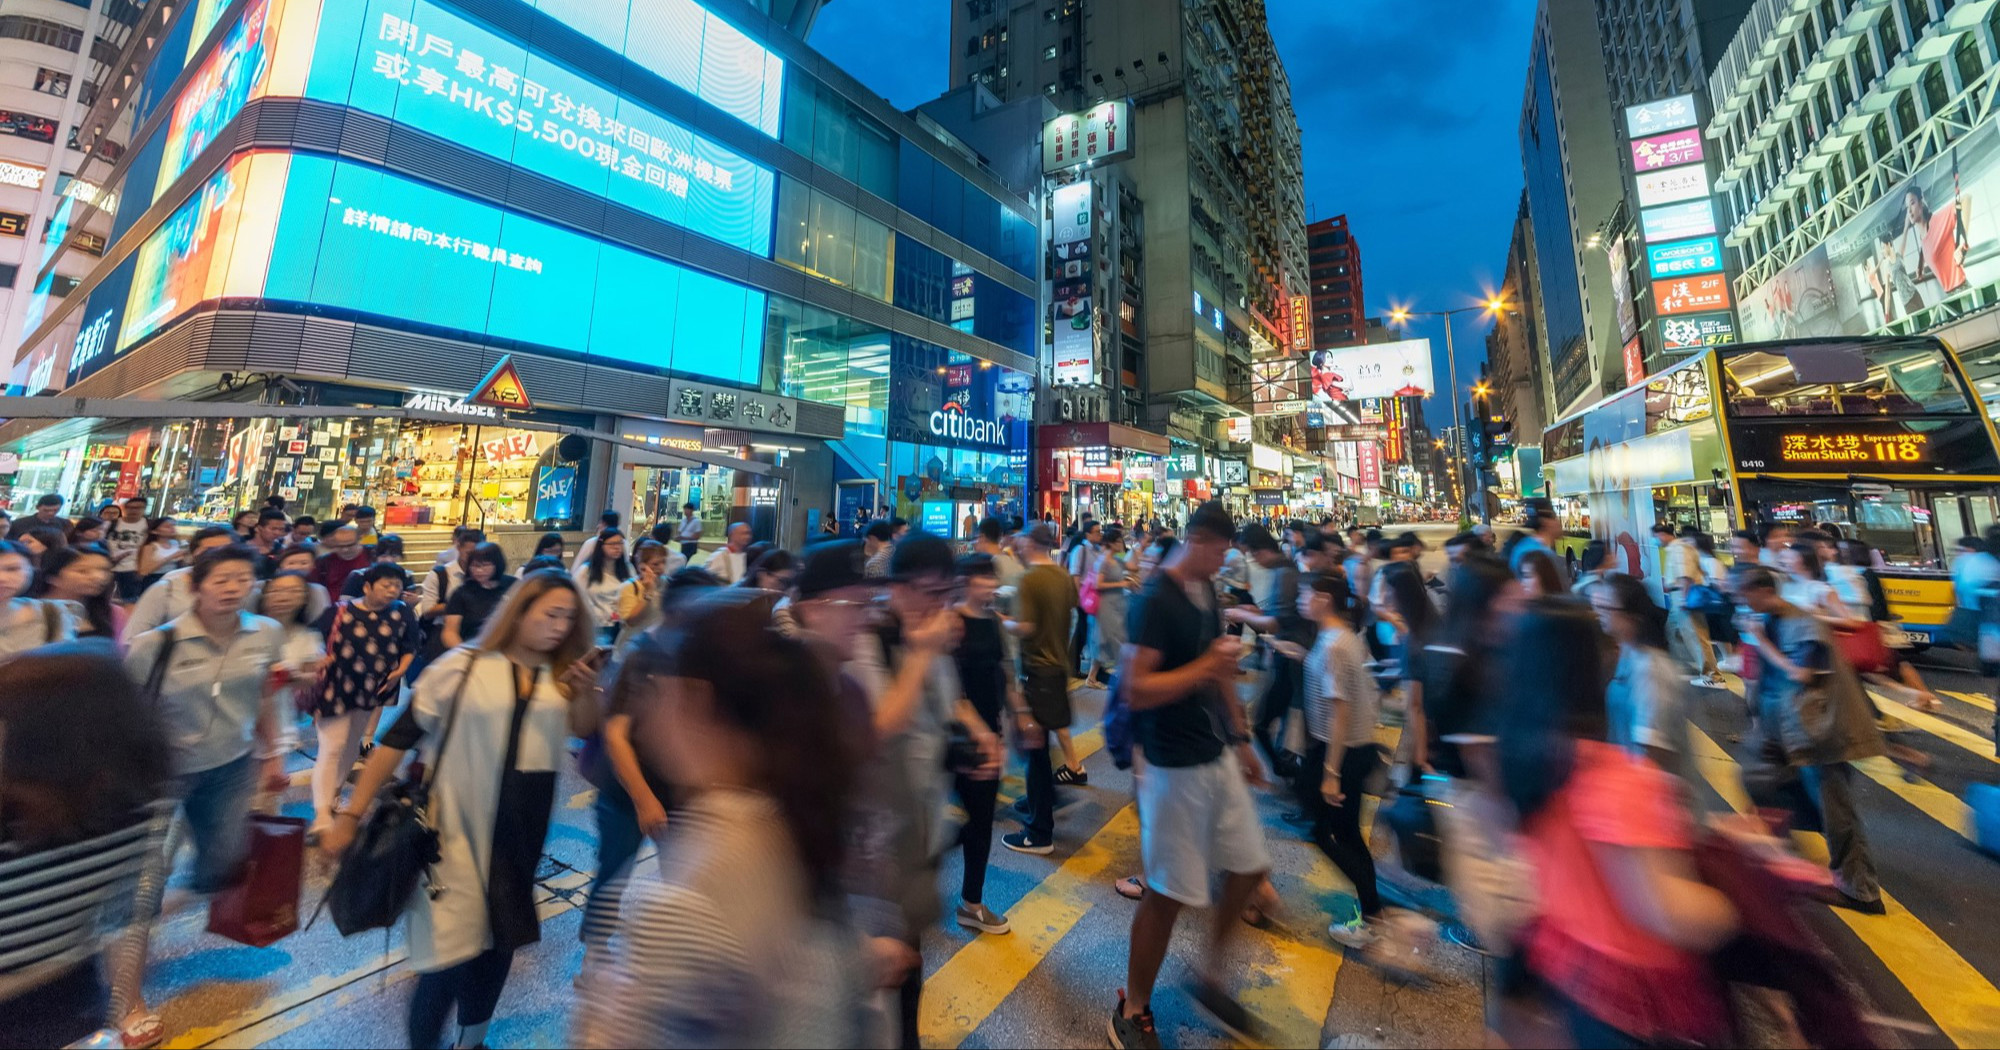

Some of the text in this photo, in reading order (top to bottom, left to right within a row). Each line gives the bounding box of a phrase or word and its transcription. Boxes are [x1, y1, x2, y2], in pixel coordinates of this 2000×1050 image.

[379, 12, 733, 191] 開戶最高可兌換來回歐洲機票
[373, 50, 689, 199] 或享HK$5,500現金回贈
[1669, 149, 1694, 164] 3/F
[342, 207, 543, 274] 詳情請向本行職員查詢
[1701, 279, 1719, 288] 2/F
[930, 409, 1006, 446] citibank
[487, 433, 533, 462] SALE!
[660, 437, 702, 451] FORTRESS
[1875, 442, 1920, 461] 118
[1164, 454, 1197, 472] 六福
[1741, 460, 1765, 468] 8410
[1783, 450, 1869, 460] Sham Shui Po
[540, 477, 574, 501] SALE!
